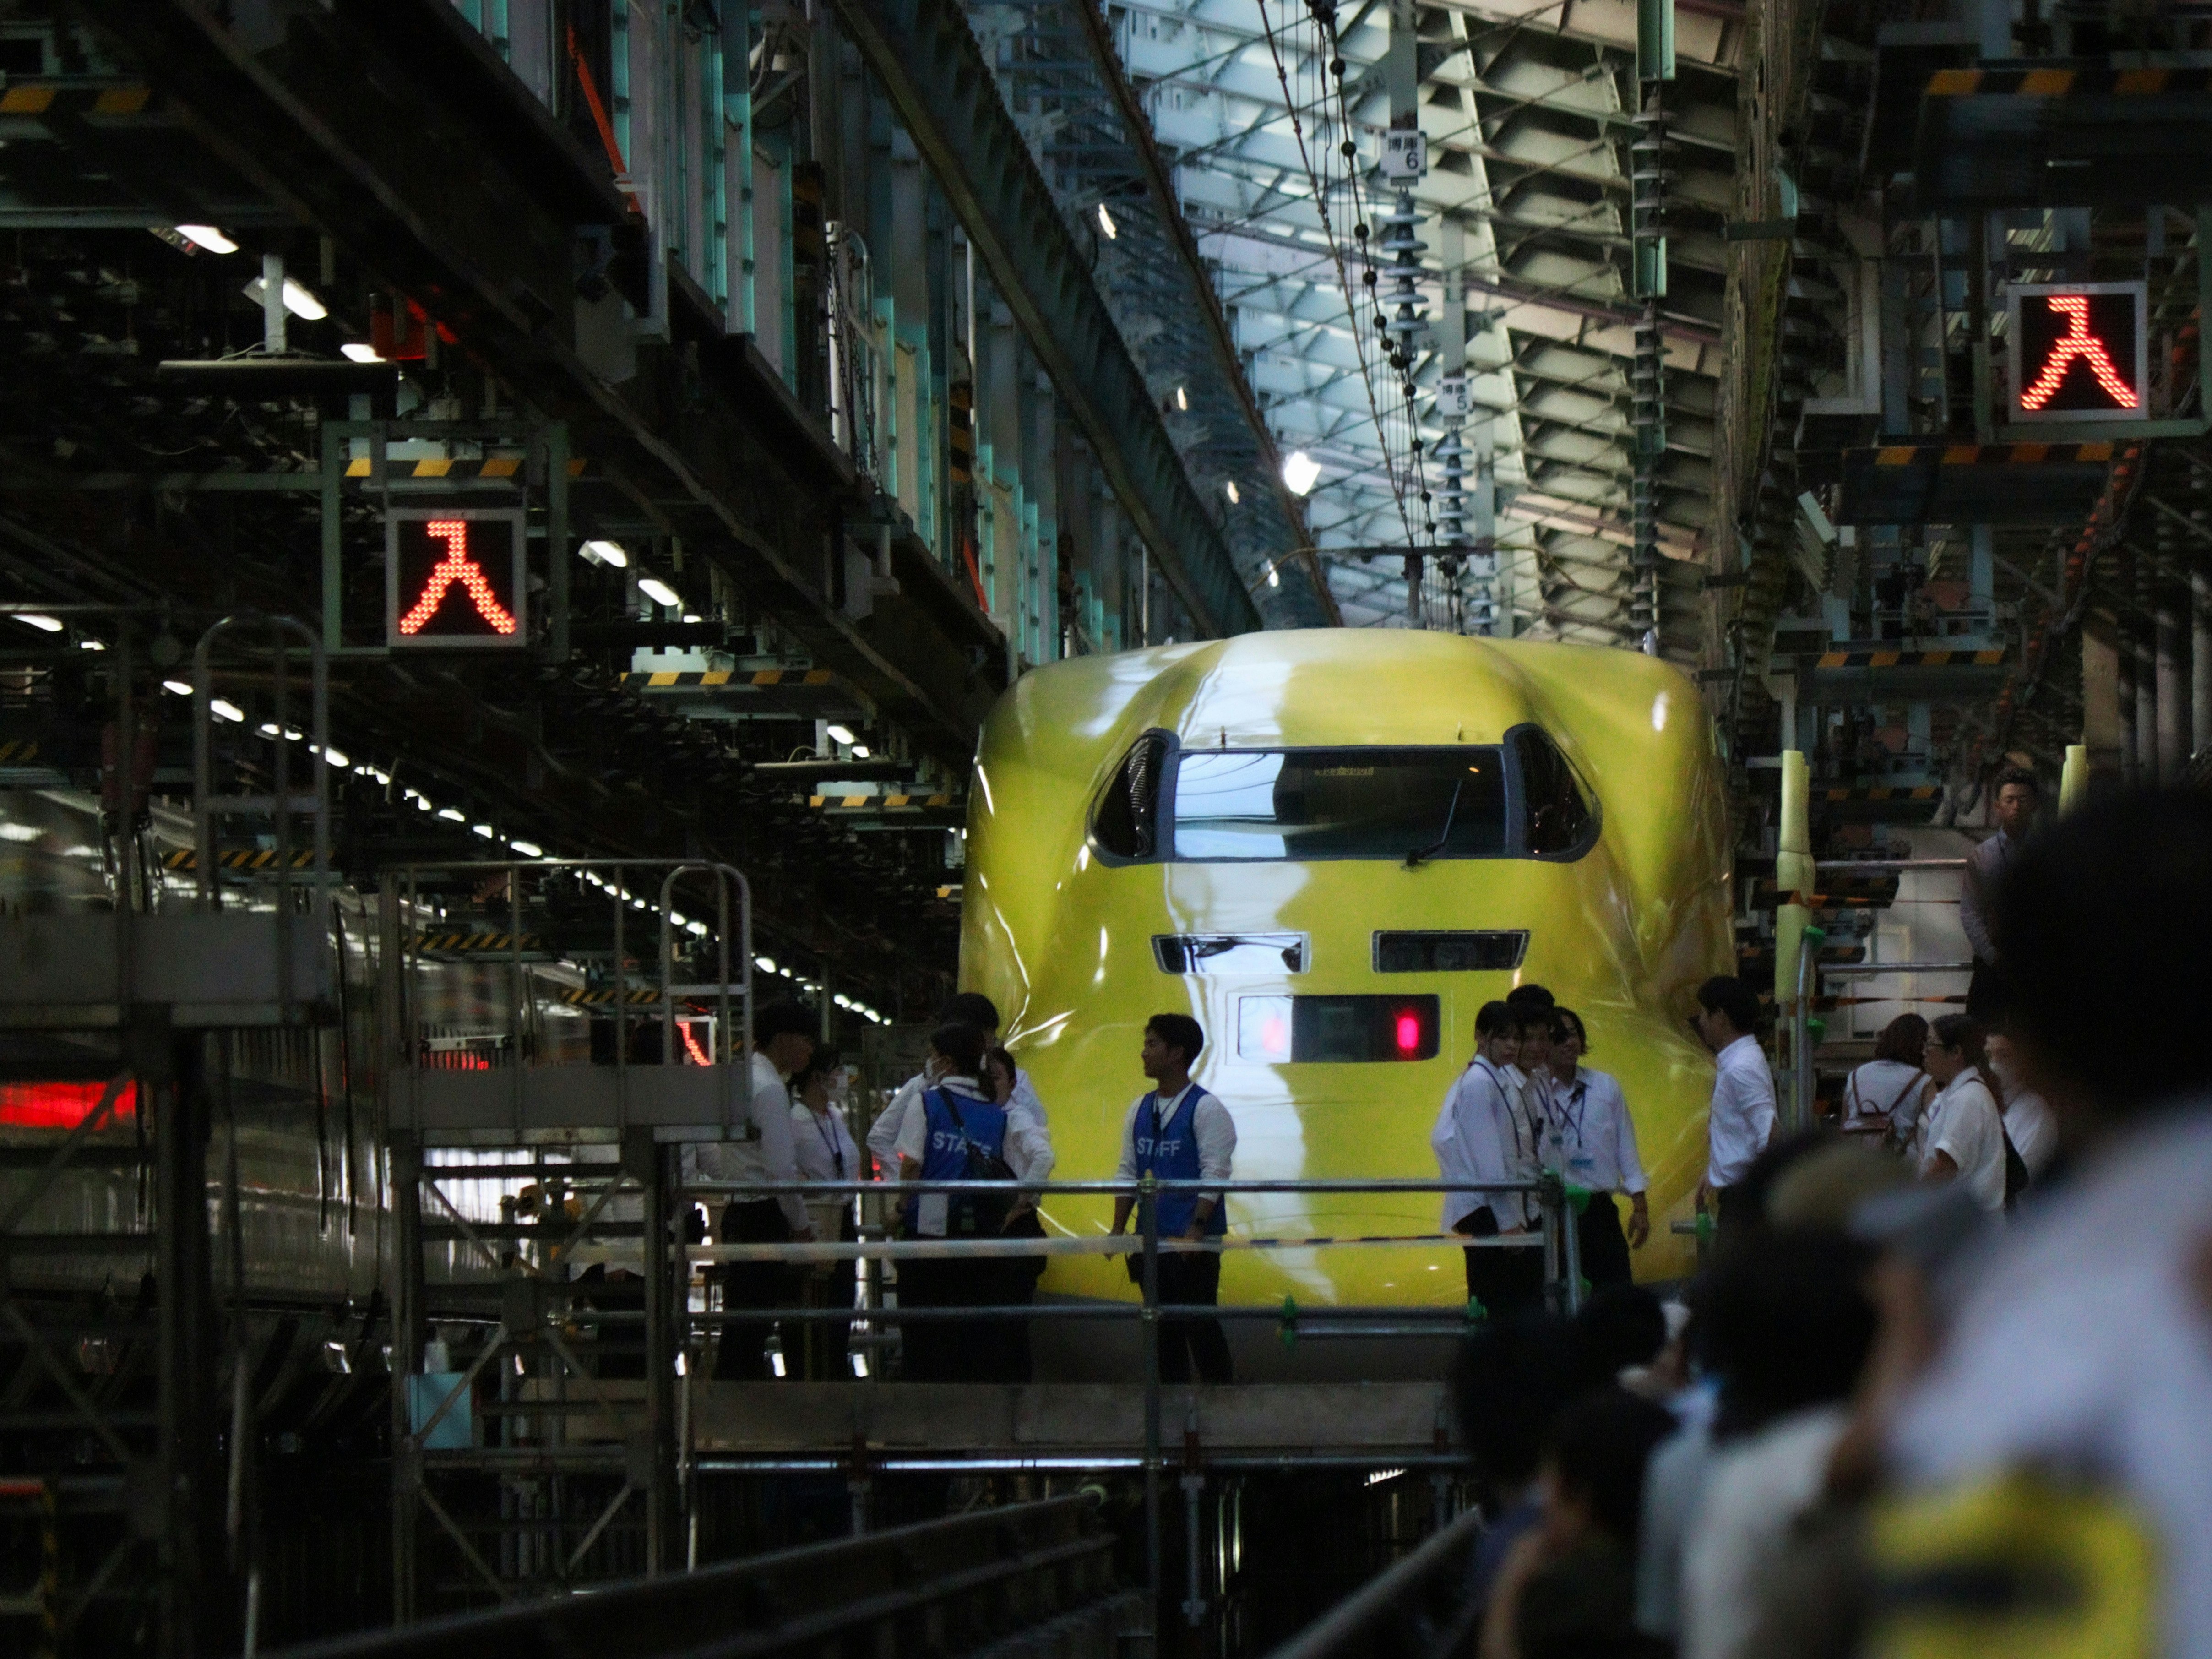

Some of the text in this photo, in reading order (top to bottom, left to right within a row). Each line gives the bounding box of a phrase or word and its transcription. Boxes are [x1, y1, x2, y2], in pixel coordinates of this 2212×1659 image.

[1407, 152, 1418, 169] 6
[2021, 297, 2139, 409] 入
[1457, 395, 1467, 410] 5
[400, 521, 515, 634] 入
[1137, 1137, 1180, 1157] STFF
